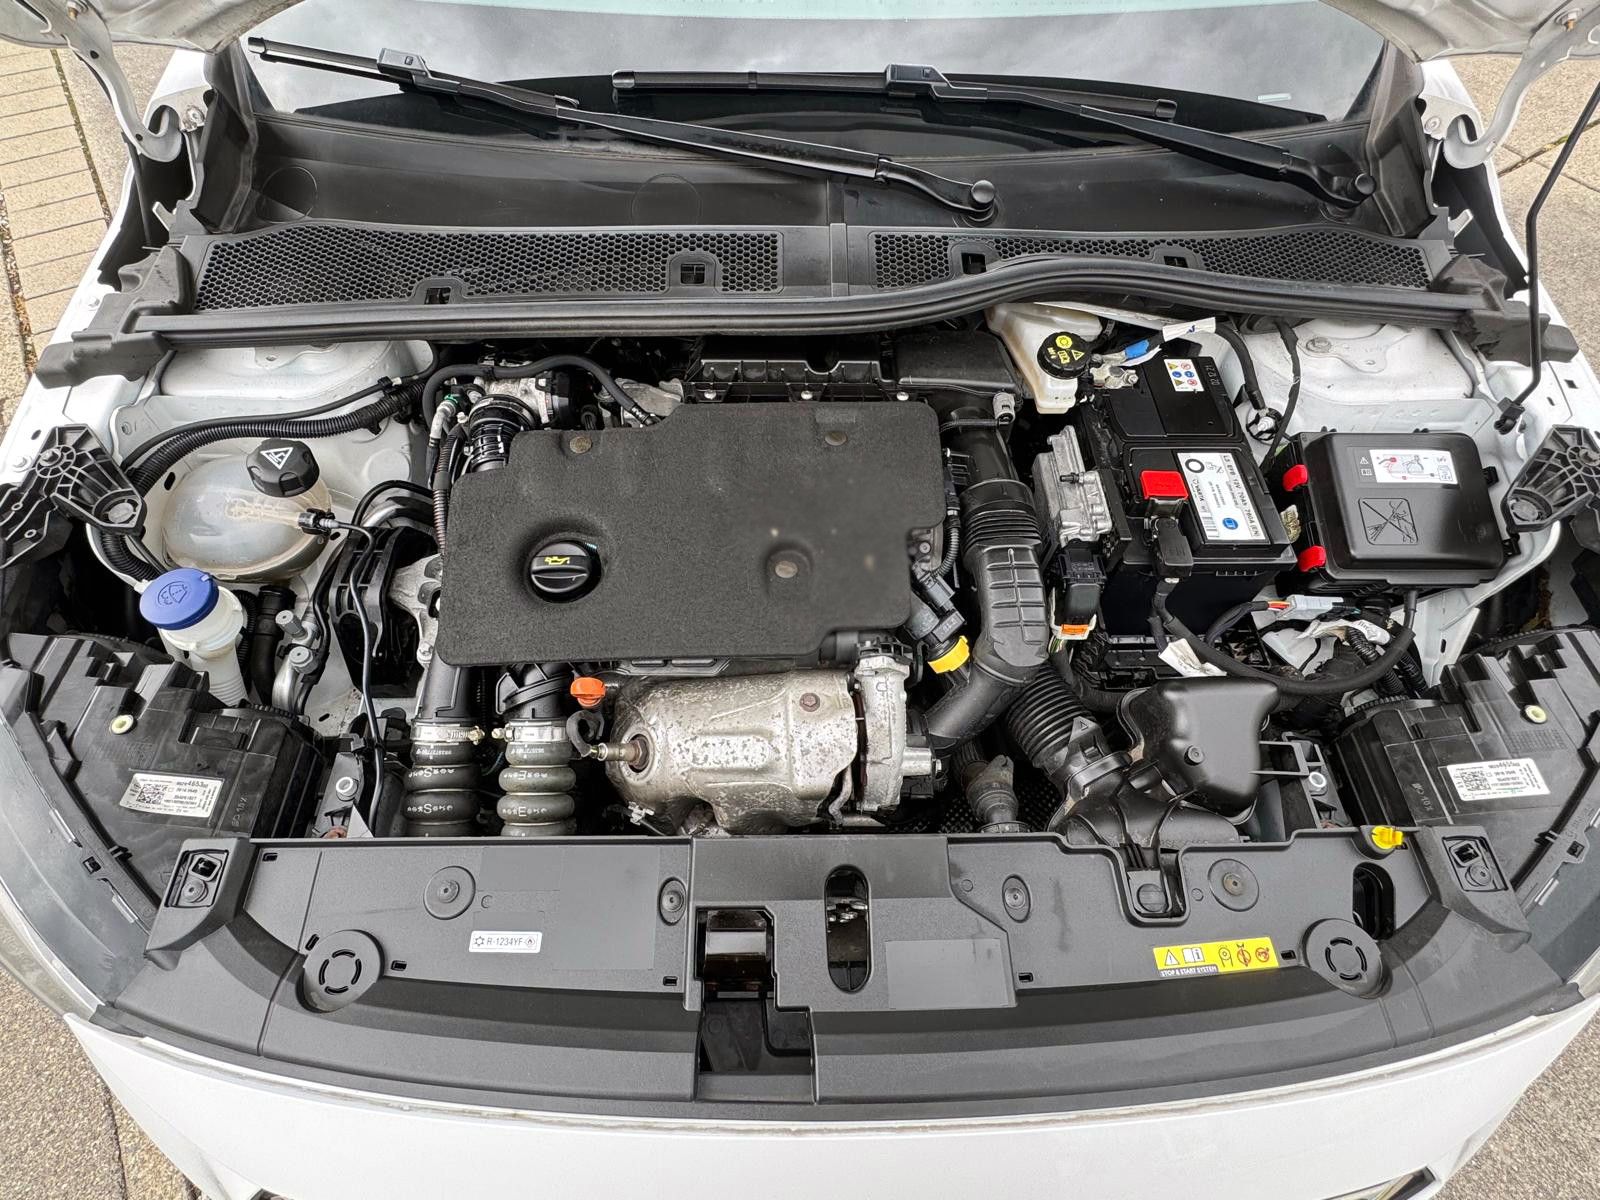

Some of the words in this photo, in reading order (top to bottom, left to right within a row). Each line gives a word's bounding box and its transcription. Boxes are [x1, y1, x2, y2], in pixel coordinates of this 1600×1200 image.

[1193, 484, 1205, 501] VARTA
[1231, 478, 1241, 489] 12V
[1236, 491, 1248, 506] 70Ah
[487, 937, 523, 946] R-1234YF
[1198, 966, 1217, 974] SYSTEM
